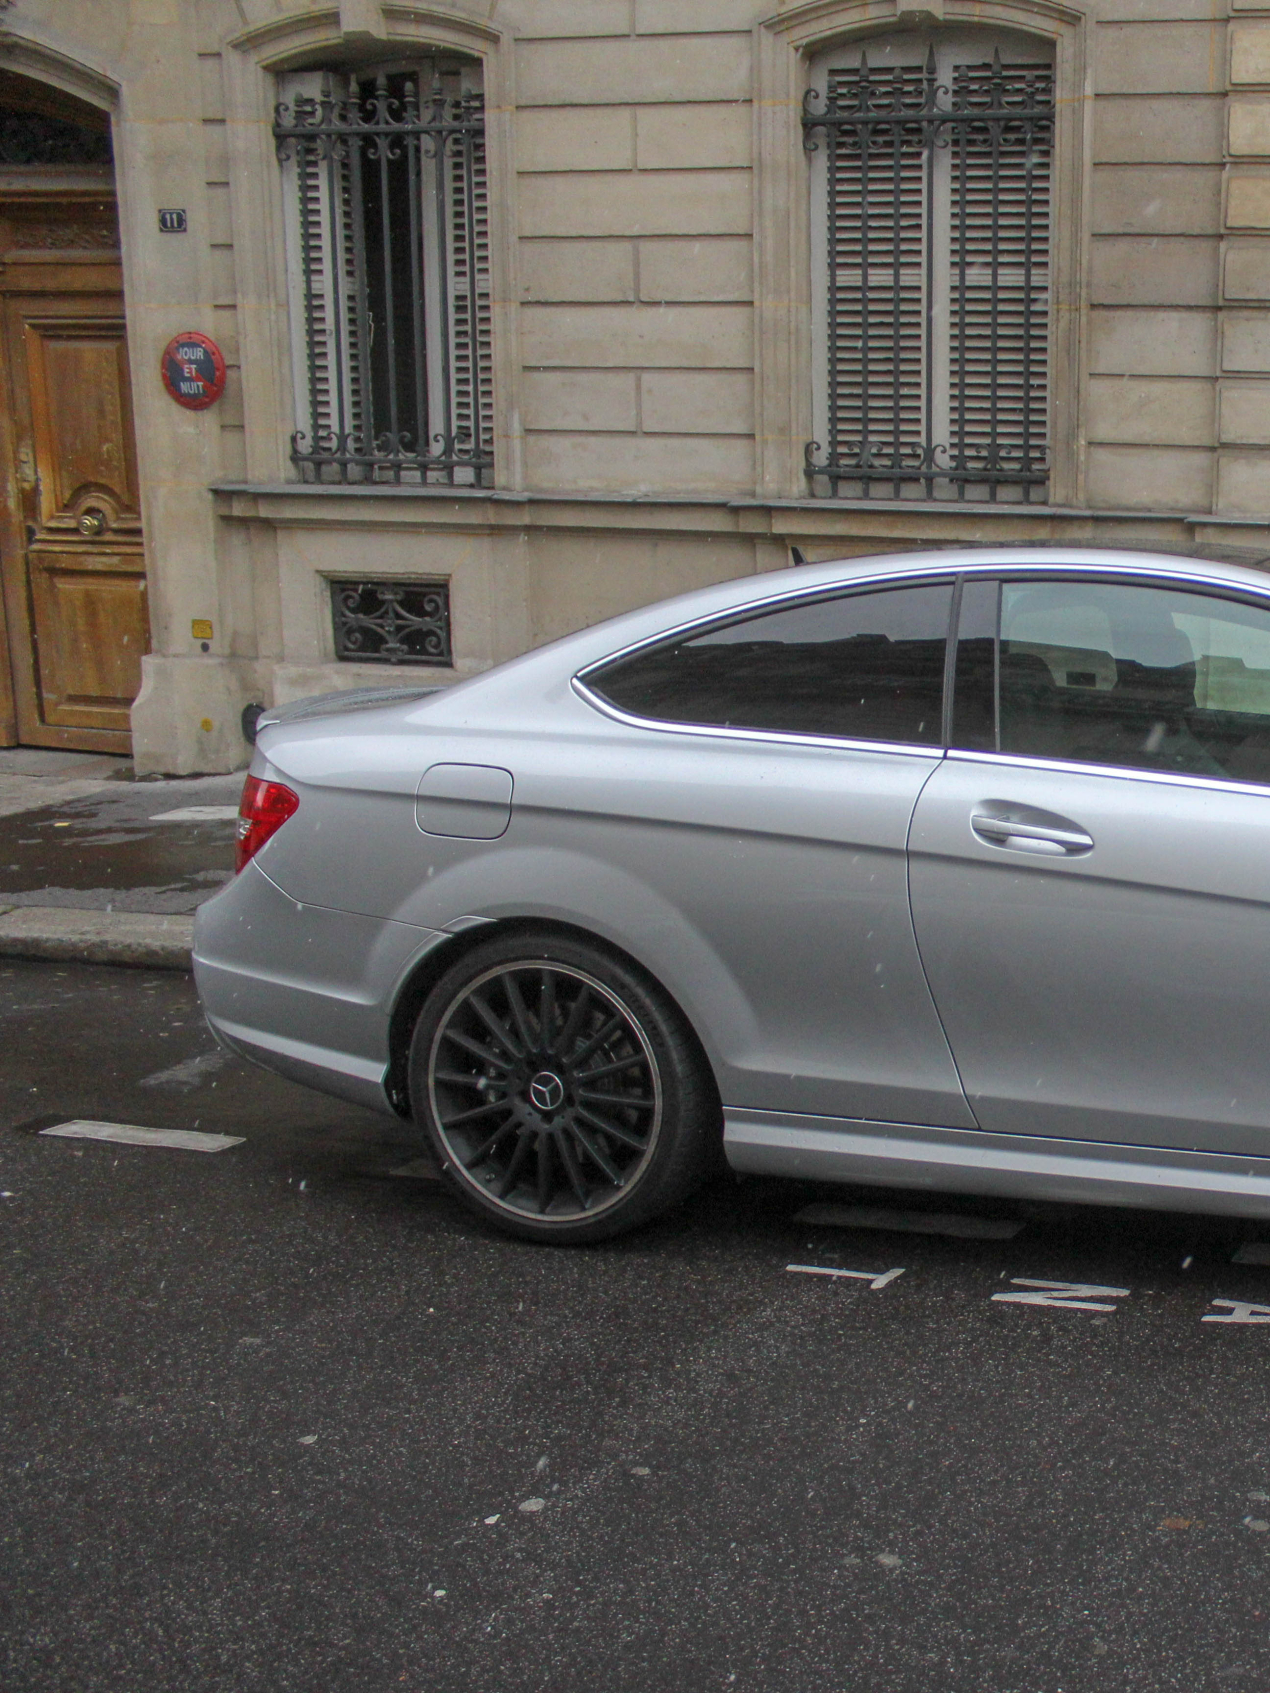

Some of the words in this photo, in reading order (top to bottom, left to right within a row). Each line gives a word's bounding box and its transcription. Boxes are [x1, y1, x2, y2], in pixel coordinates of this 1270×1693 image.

[164, 213, 178, 229] 11
[177, 347, 204, 360] JOUR
[183, 365, 197, 377] ET
[180, 382, 204, 394] NUIT
